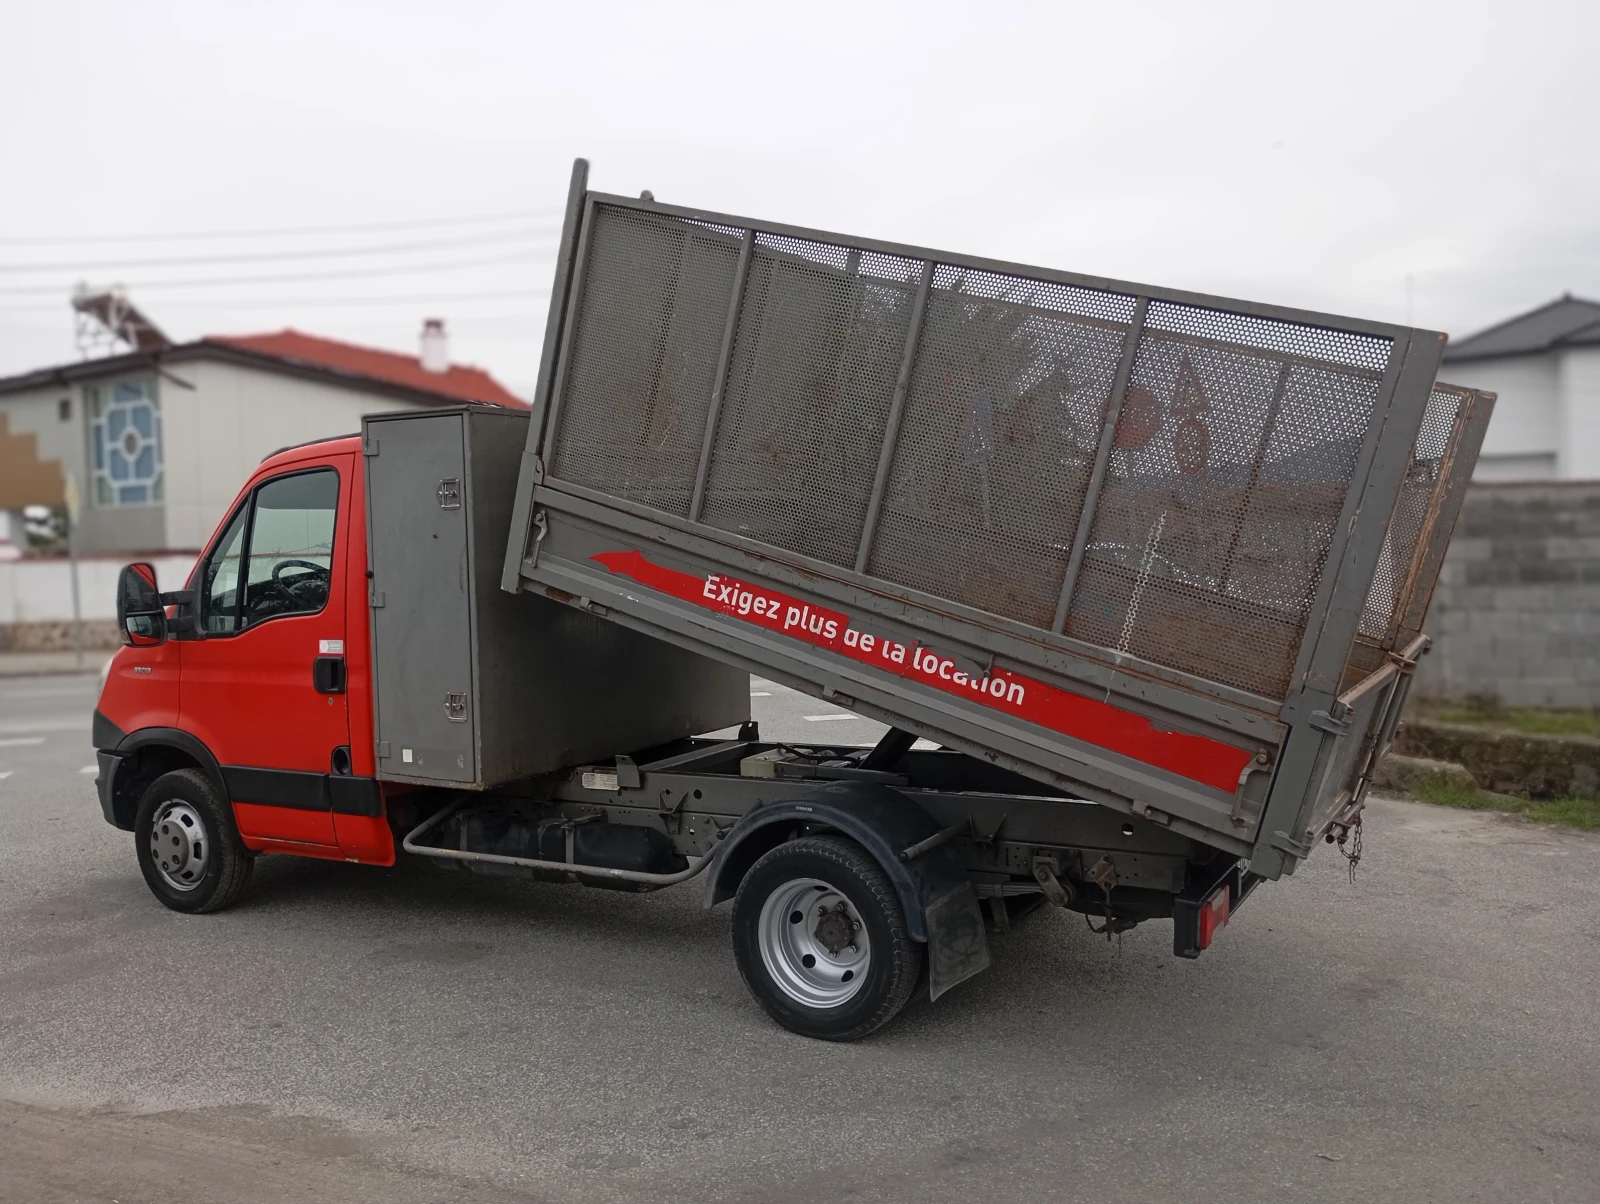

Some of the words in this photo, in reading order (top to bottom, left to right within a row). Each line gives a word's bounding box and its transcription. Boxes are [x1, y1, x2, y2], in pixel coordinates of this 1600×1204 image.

[703, 575, 781, 618] Exigez
[784, 605, 838, 638] plus
[882, 641, 906, 664] la
